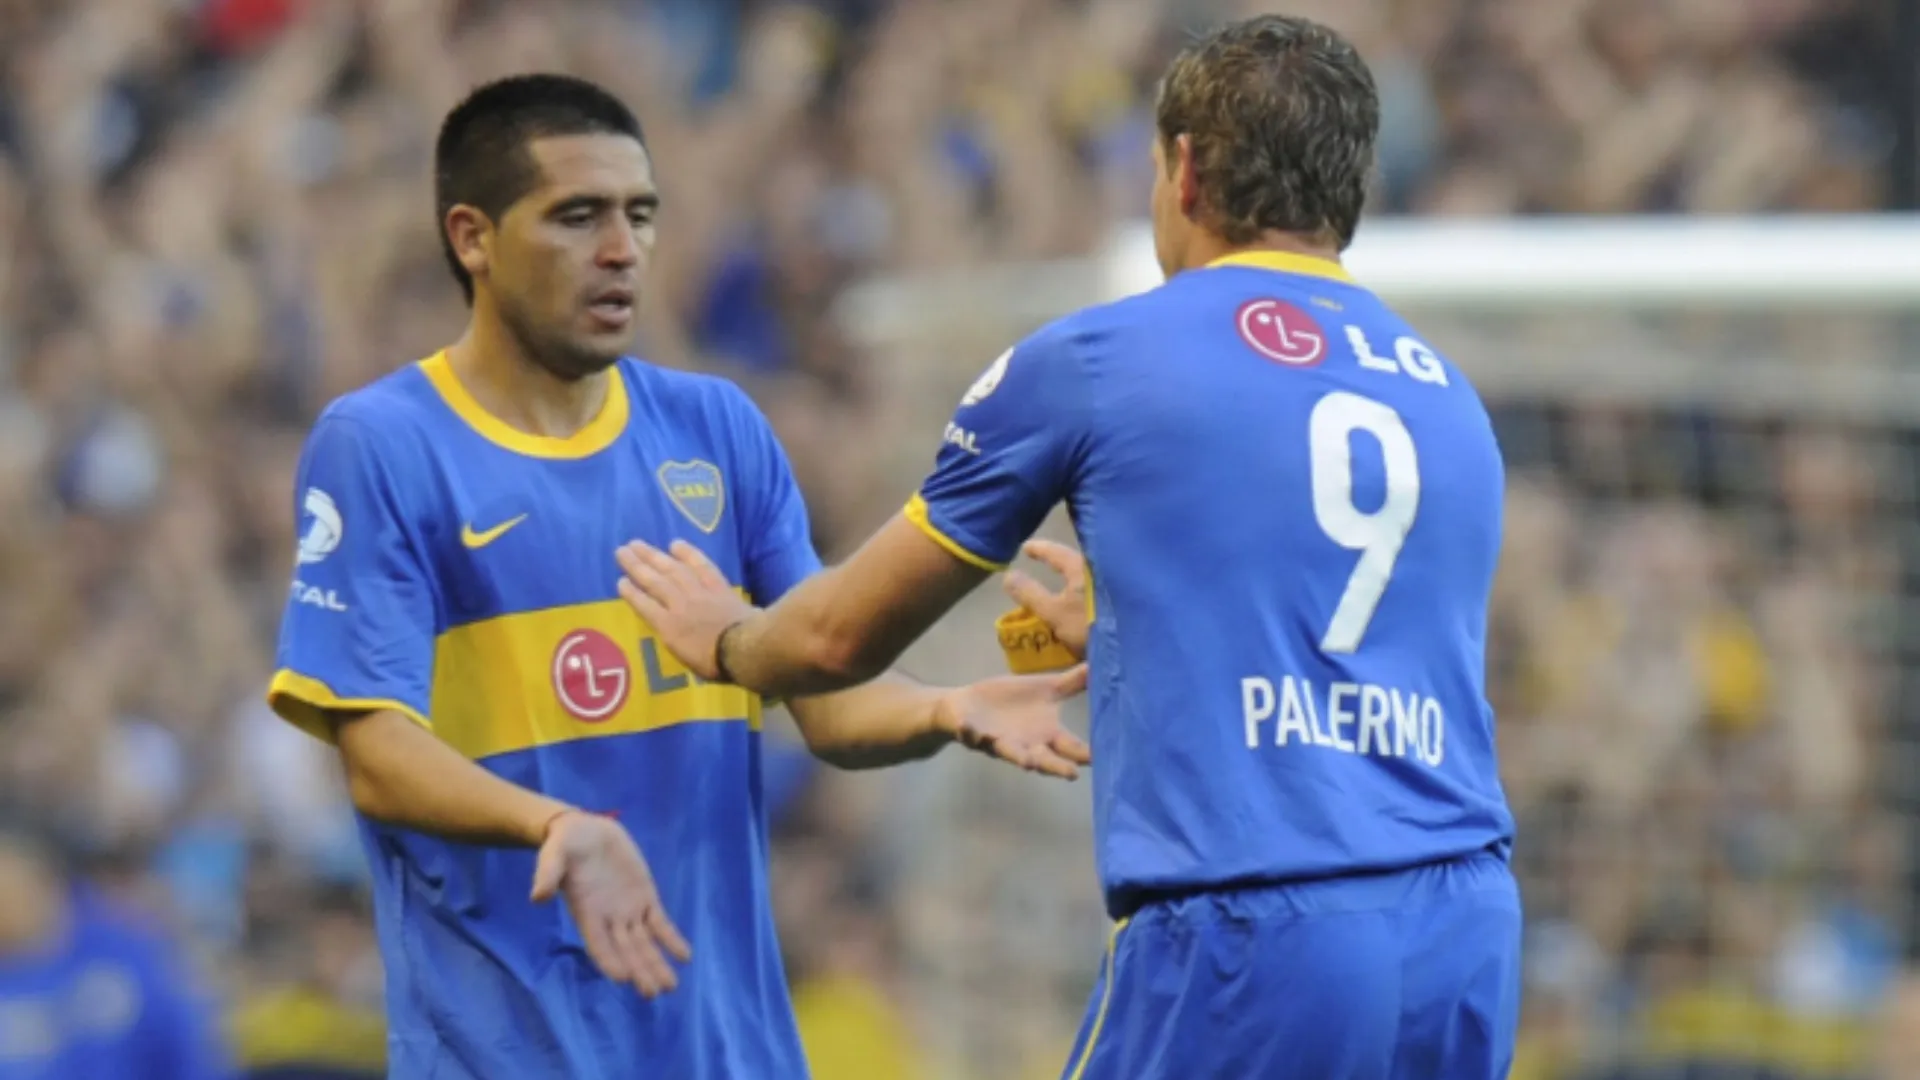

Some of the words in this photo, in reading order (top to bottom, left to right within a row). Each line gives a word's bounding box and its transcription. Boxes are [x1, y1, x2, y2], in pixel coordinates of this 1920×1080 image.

[1343, 324, 1449, 388] LG
[1309, 391, 1421, 654] 9
[1240, 674, 1444, 767] PALERMO
